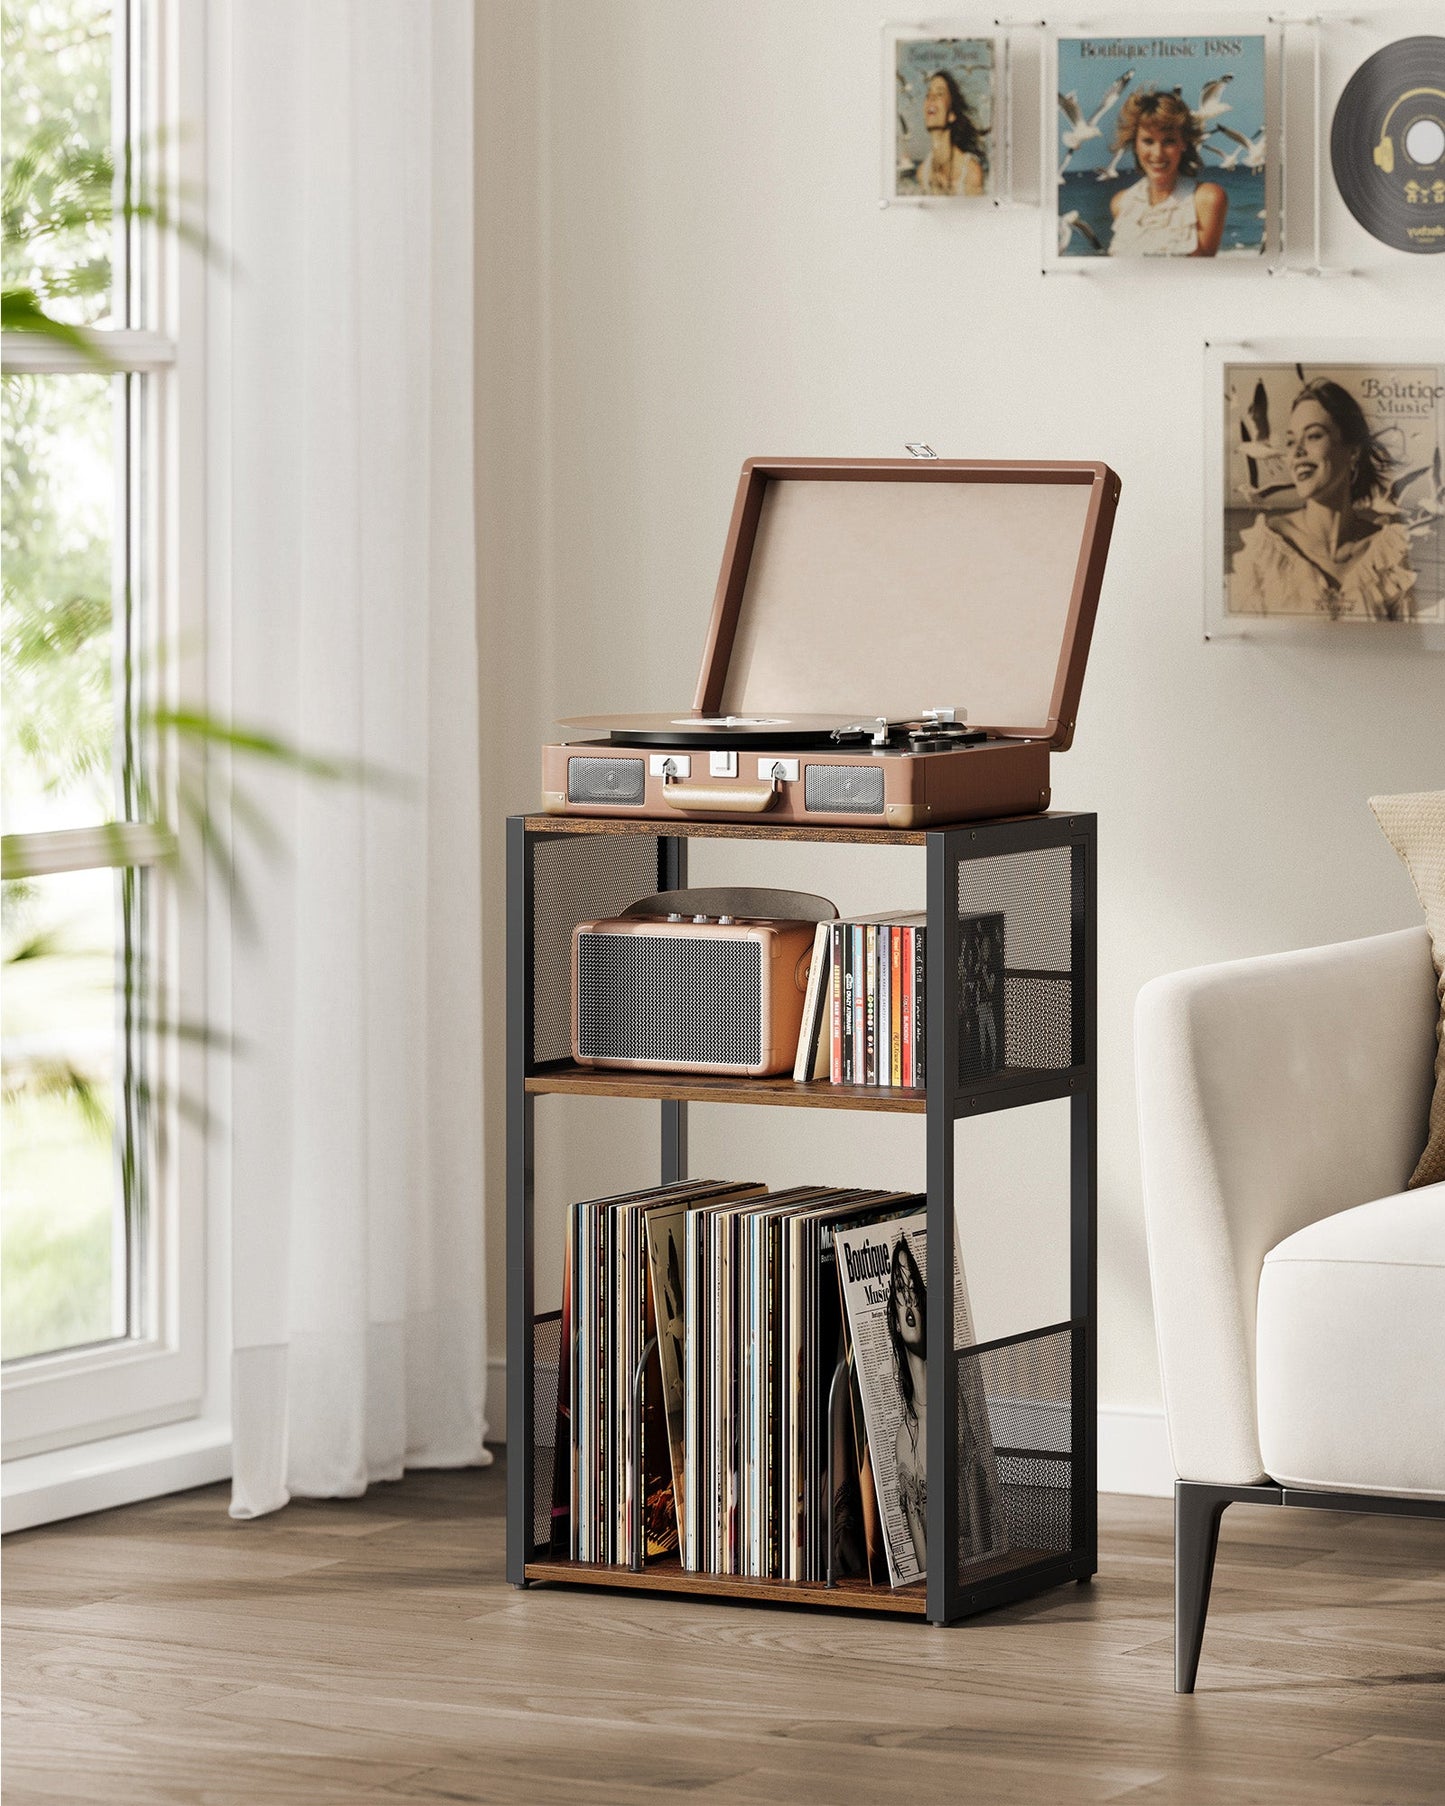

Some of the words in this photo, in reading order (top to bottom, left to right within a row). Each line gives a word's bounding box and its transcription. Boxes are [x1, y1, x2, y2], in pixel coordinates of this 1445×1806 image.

[1080, 38, 1150, 60] Boutique
[1204, 39, 1242, 57] 1988
[1377, 399, 1430, 414] Music
[843, 1238, 891, 1285] Boutique
